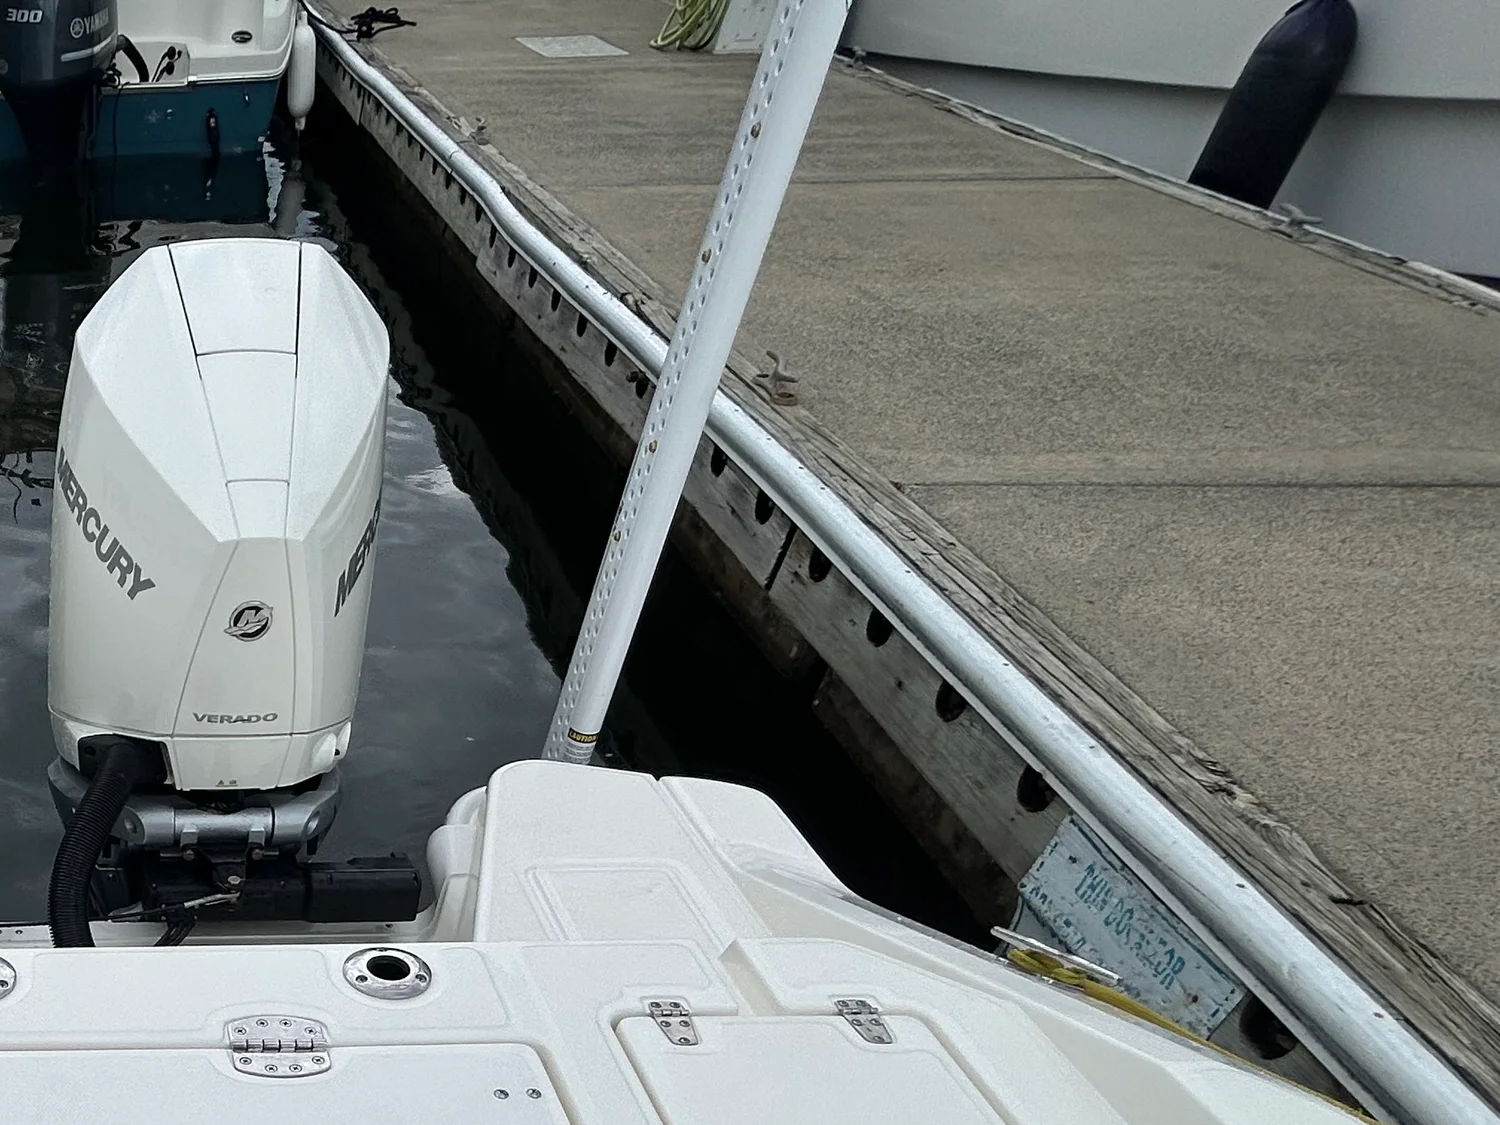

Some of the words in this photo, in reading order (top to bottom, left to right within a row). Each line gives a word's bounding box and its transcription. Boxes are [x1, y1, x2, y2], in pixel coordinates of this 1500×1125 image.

[6, 8, 43, 23] 300
[84, 7, 110, 34] YAMAH
[56, 445, 156, 600] MERCURY
[192, 712, 278, 724] VERADO
